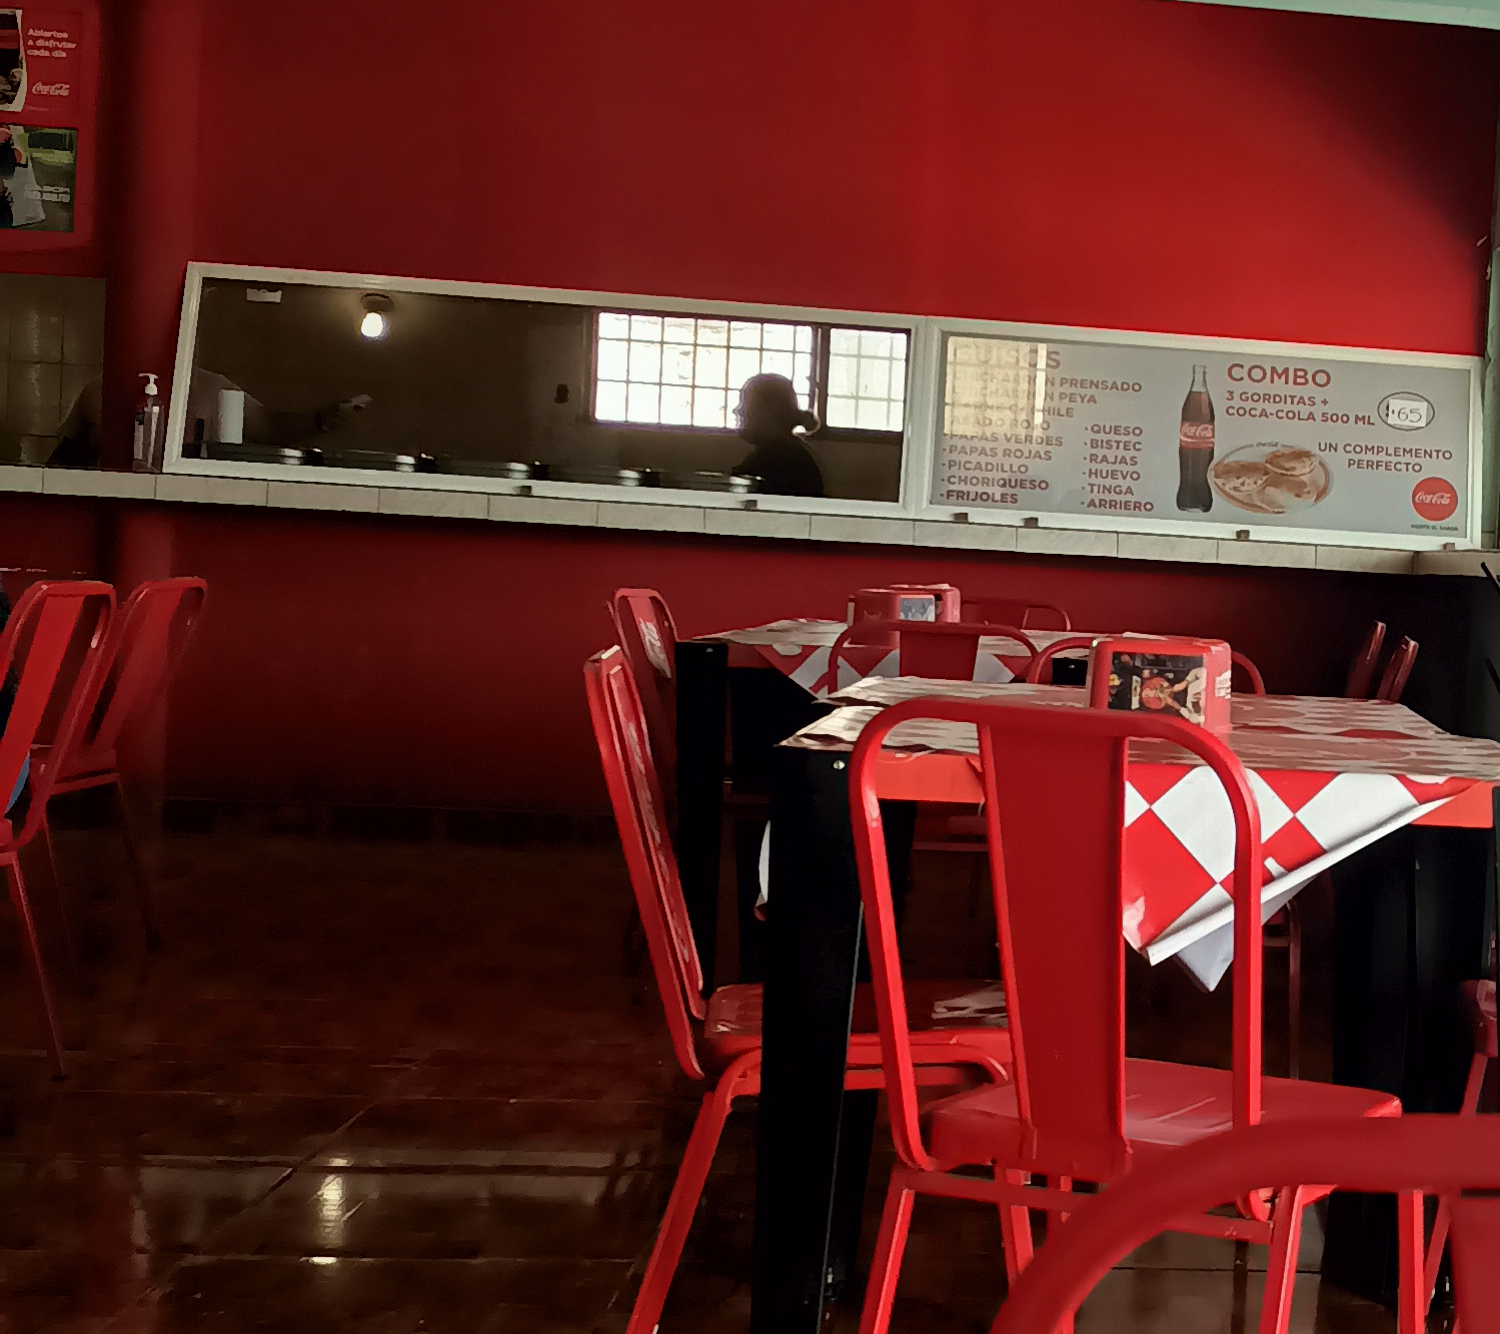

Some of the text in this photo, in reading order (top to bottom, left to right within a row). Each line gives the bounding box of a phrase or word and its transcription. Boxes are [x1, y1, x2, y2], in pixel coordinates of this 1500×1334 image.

[1227, 362, 1331, 389] COMBO
[1060, 377, 1142, 393] PRENSADO
[1059, 392, 1098, 404] PEYA
[1226, 390, 1235, 402] 3
[1239, 391, 1316, 408] GORDITAS
[1226, 405, 1376, 427] COCA-COLA 500 ML
[1090, 423, 1143, 437] QUESO
[1004, 433, 1064, 447] VERDES
[1090, 438, 1143, 452] BISTEC
[948, 445, 1052, 461] PAPAS ROJAS
[1318, 441, 1454, 461] UN COMPLEMENTO
[1089, 453, 1138, 466] RAJAS
[1348, 458, 1423, 474] PERFECTO
[948, 460, 1029, 474] PICADILLO
[1088, 468, 1140, 482] HUEVO
[946, 474, 1050, 491] CHORIQUESO
[1087, 483, 1134, 496] TINGA
[946, 490, 1018, 504] FRIJOLES
[1086, 498, 1154, 513] ARRIERO
